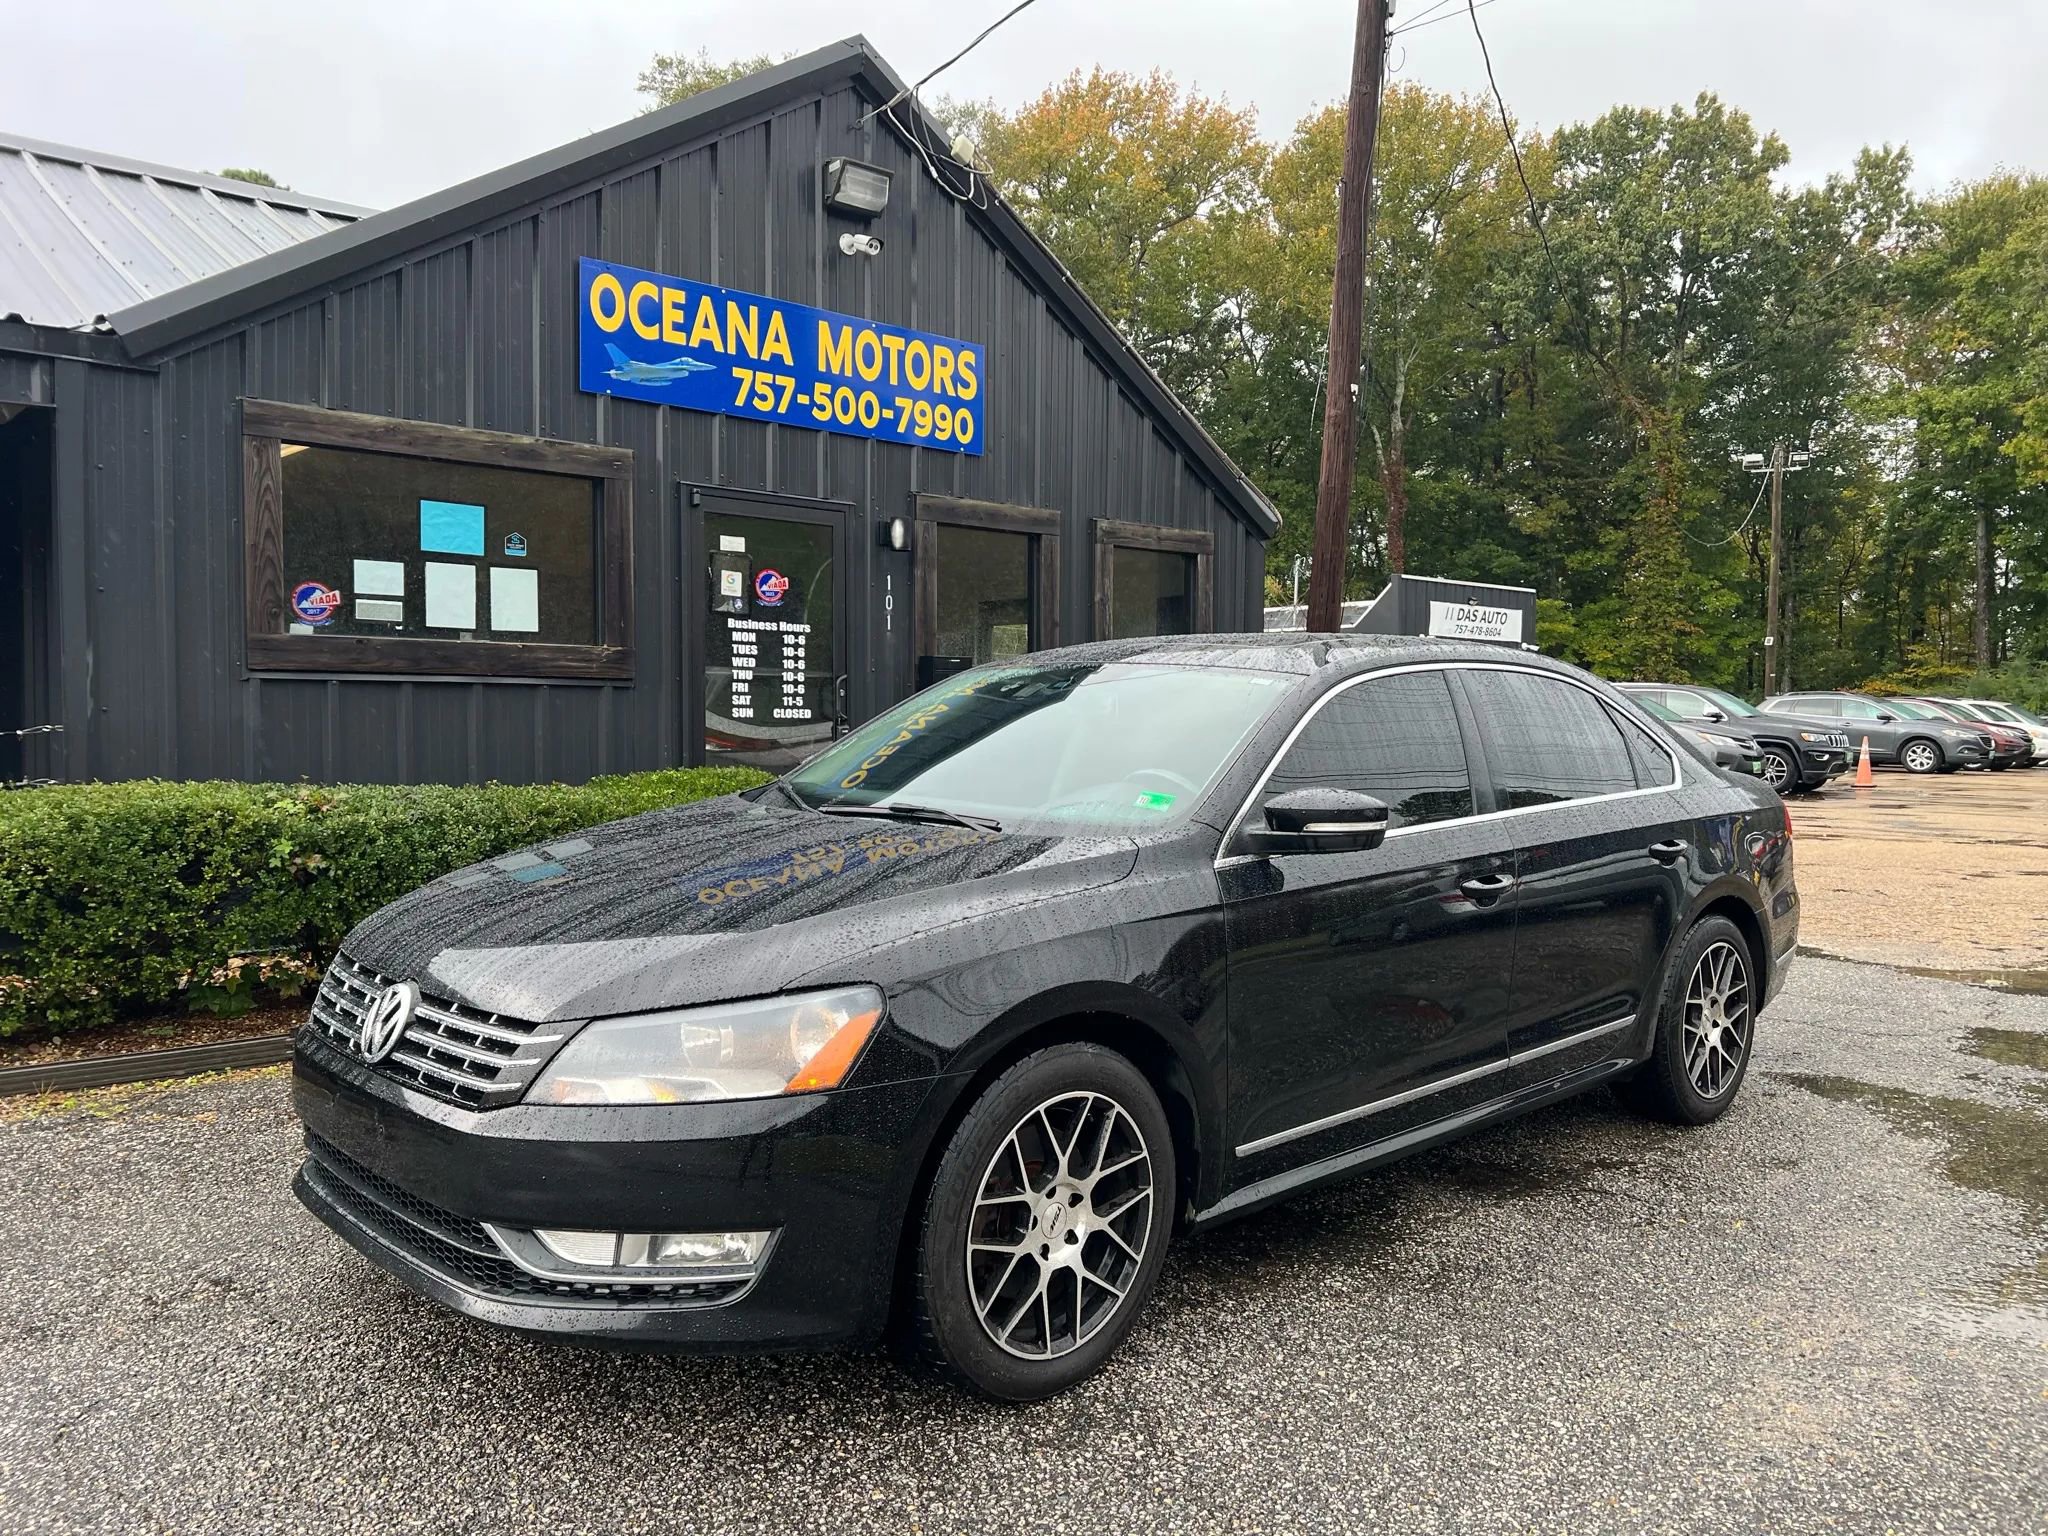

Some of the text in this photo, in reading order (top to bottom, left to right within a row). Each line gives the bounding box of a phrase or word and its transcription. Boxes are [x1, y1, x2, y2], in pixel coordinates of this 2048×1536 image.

[590, 273, 978, 401] OCEANA MOTORS
[731, 367, 974, 444] 757-500-7990
[309, 593, 337, 605] VIADA
[1457, 608, 1479, 622] DAS
[1480, 610, 1508, 625] AUTO
[727, 618, 811, 633] Business Hours
[1454, 624, 1502, 637] 757-478-8604
[732, 632, 805, 645] MON 10-6
[732, 644, 805, 657] TUES 10-6
[732, 657, 805, 670] WED 10-6
[732, 670, 805, 682] THU 10-6
[732, 682, 805, 694] FRI 10-6
[732, 695, 803, 707] SAT 11-5
[732, 708, 811, 719] SUN CLOSED
